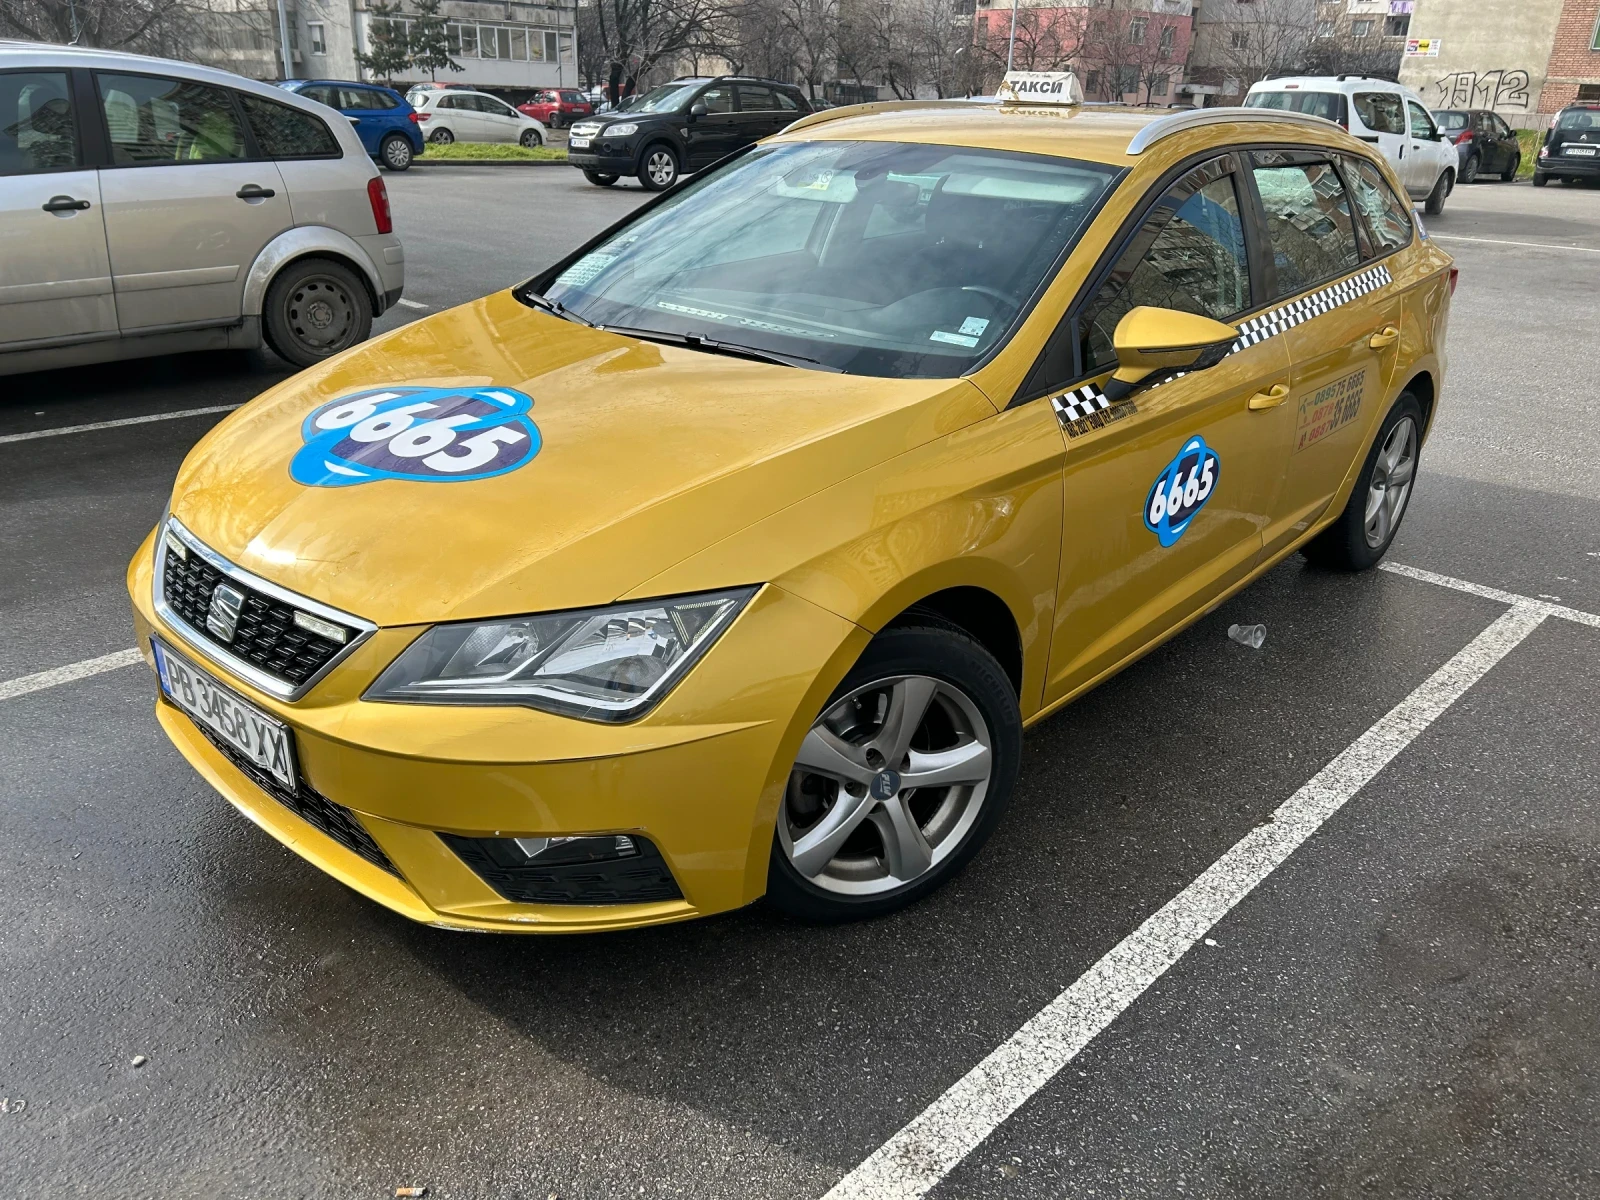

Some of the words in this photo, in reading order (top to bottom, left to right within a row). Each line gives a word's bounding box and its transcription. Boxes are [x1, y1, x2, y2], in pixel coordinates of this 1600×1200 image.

[1010, 80, 1063, 94] ТАКСИ
[1436, 69, 1529, 110] 1912
[315, 392, 527, 472] 6665
[1149, 457, 1214, 525] 6665
[165, 655, 197, 707] PB
[196, 677, 251, 749] 3458
